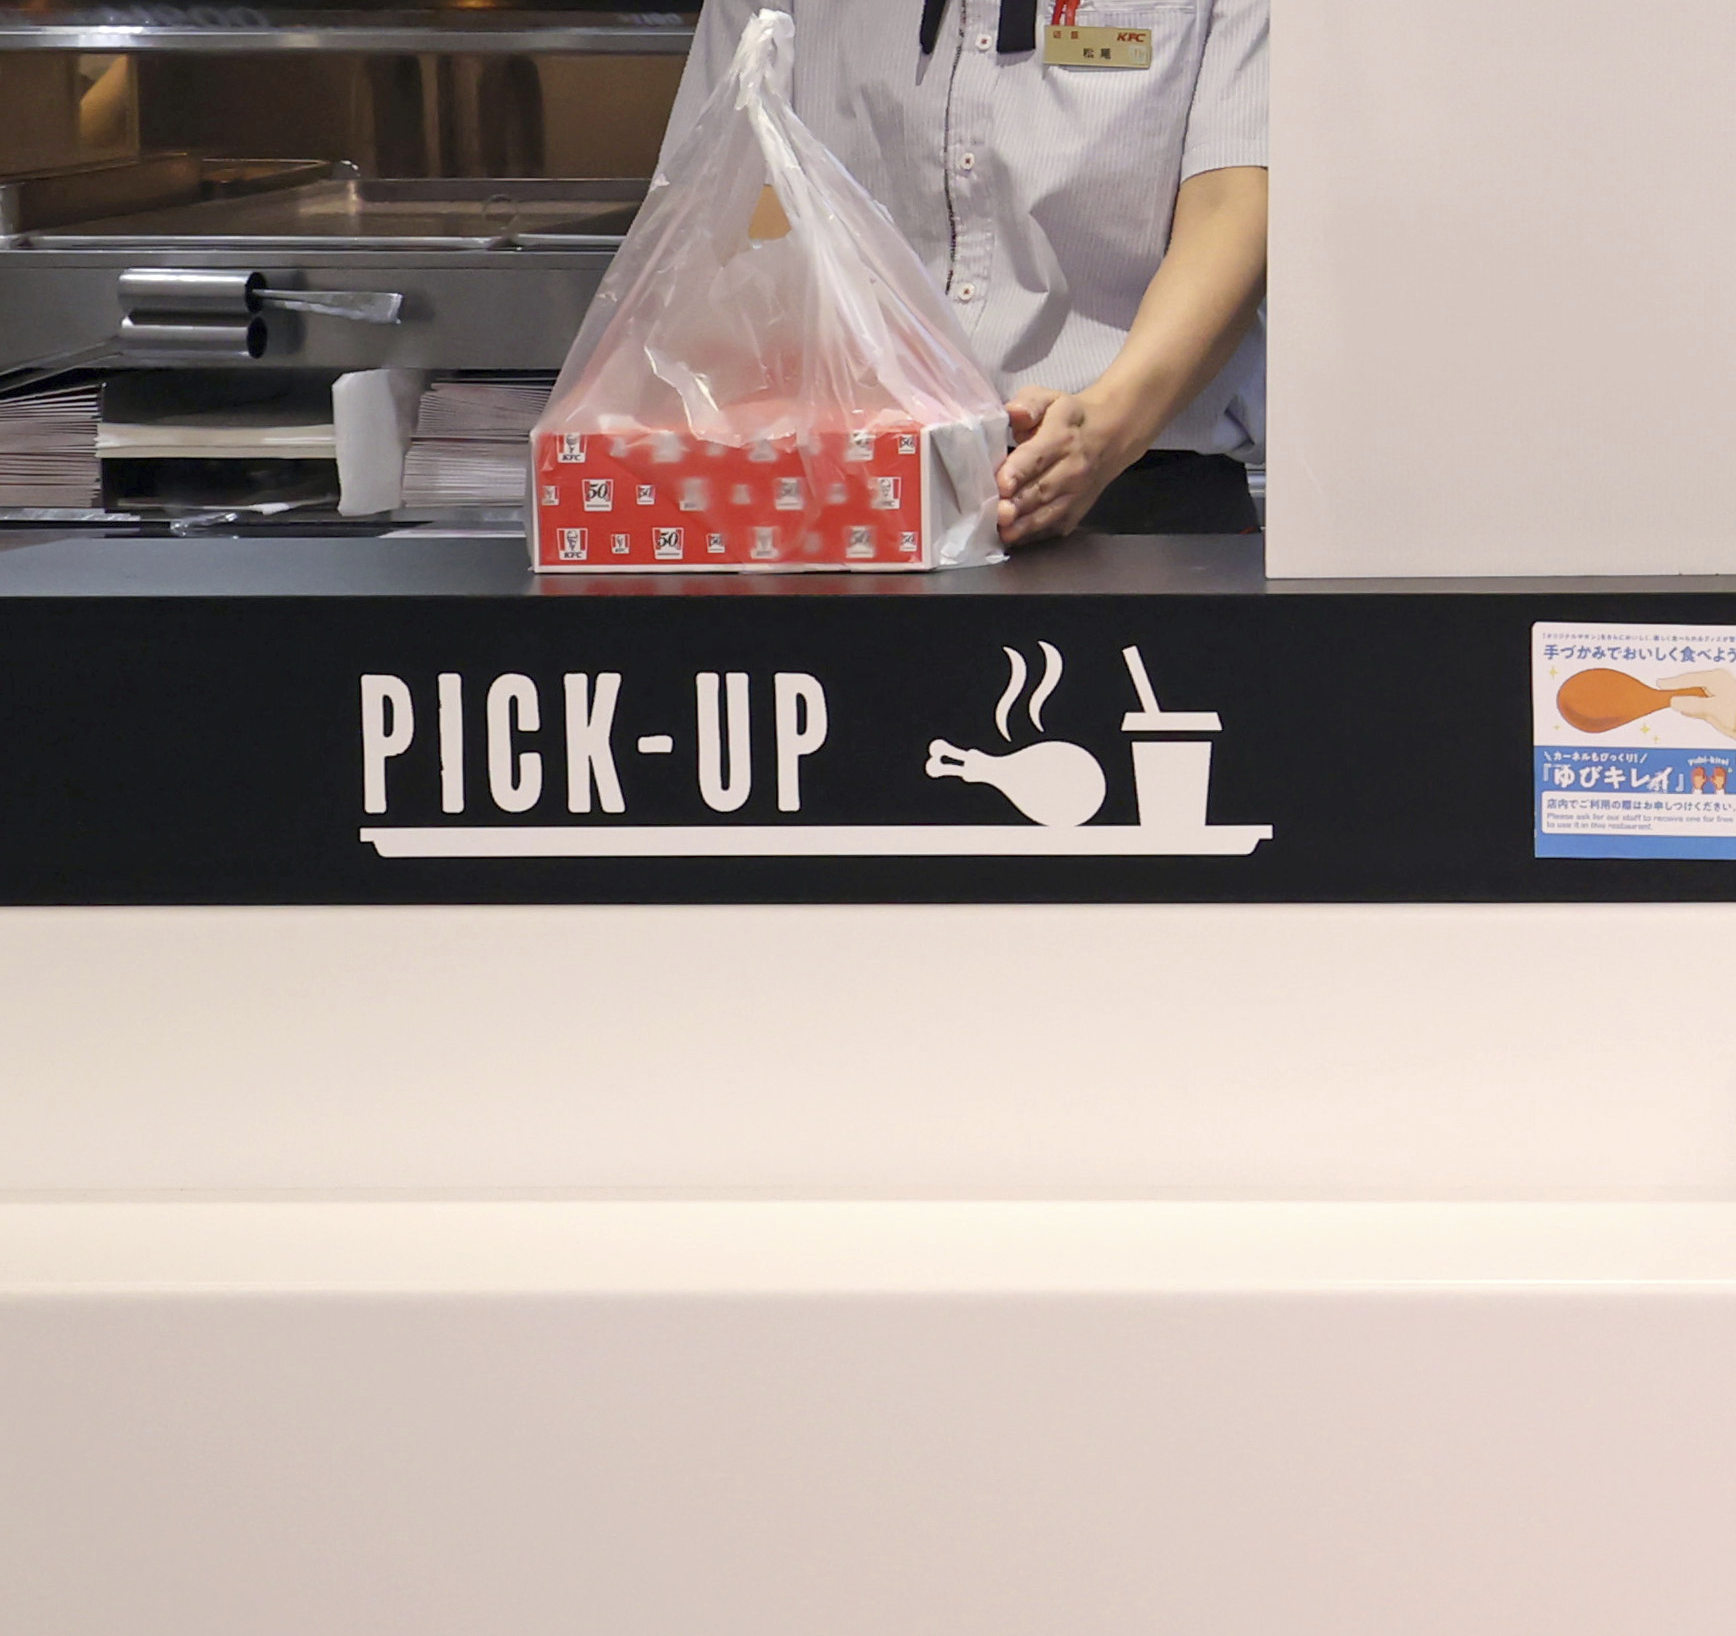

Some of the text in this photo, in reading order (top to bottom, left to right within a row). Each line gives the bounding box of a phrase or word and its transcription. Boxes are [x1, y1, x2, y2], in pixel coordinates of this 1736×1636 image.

[1116, 33, 1147, 43] KFC
[587, 483, 609, 500] 50
[656, 531, 679, 548] 50
[563, 551, 583, 559] KFC
[360, 672, 829, 814] PICK-UP
